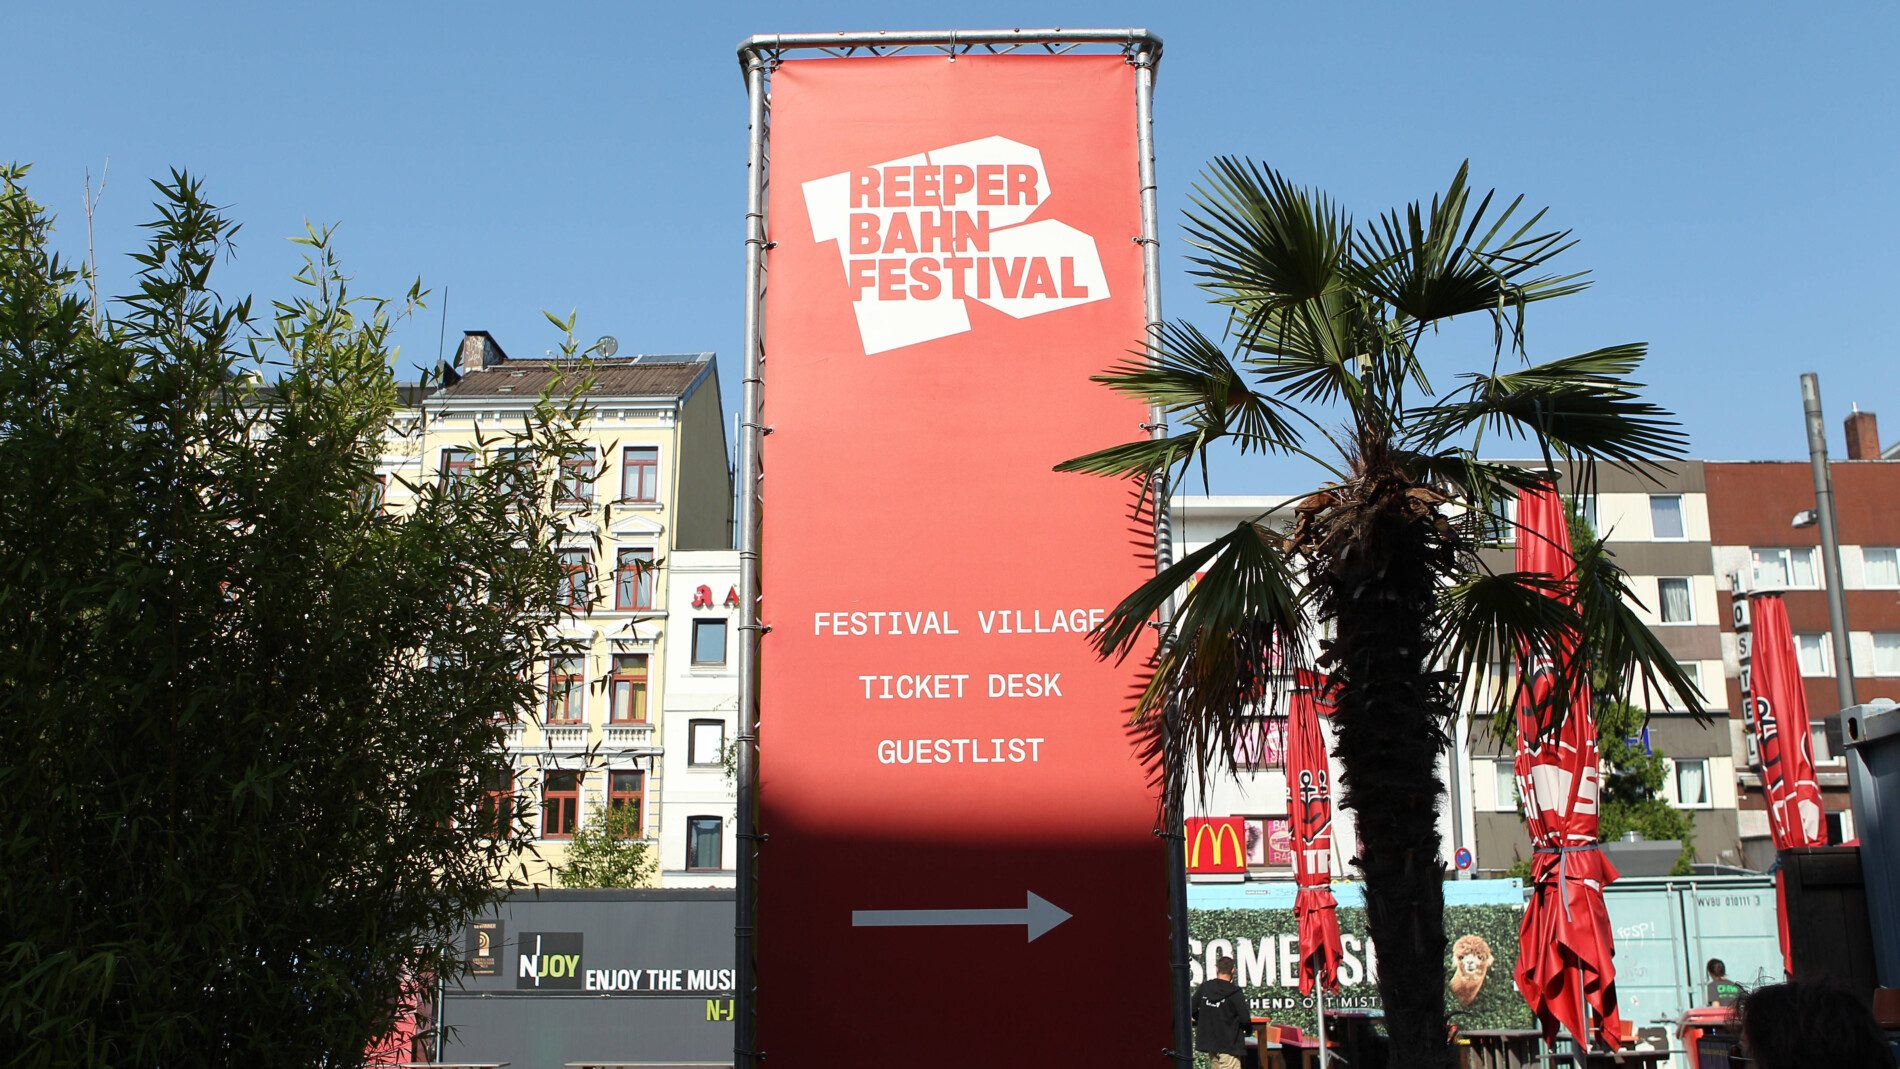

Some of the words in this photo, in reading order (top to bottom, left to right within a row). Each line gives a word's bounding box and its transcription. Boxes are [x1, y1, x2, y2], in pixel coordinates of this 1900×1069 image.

[850, 164, 1038, 208] REEPER
[850, 211, 989, 255] BAHN
[850, 257, 1088, 301] FESTIVAL
[814, 611, 959, 635] FESTIVAL
[978, 609, 1105, 633] VILLAGE
[1731, 571, 1756, 756] HOSTEL
[859, 674, 969, 699] TICKET
[988, 673, 1062, 698] DESK
[878, 738, 1044, 764] GUESTLIST
[586, 970, 641, 990] ENJOY
[646, 970, 682, 990] THE
